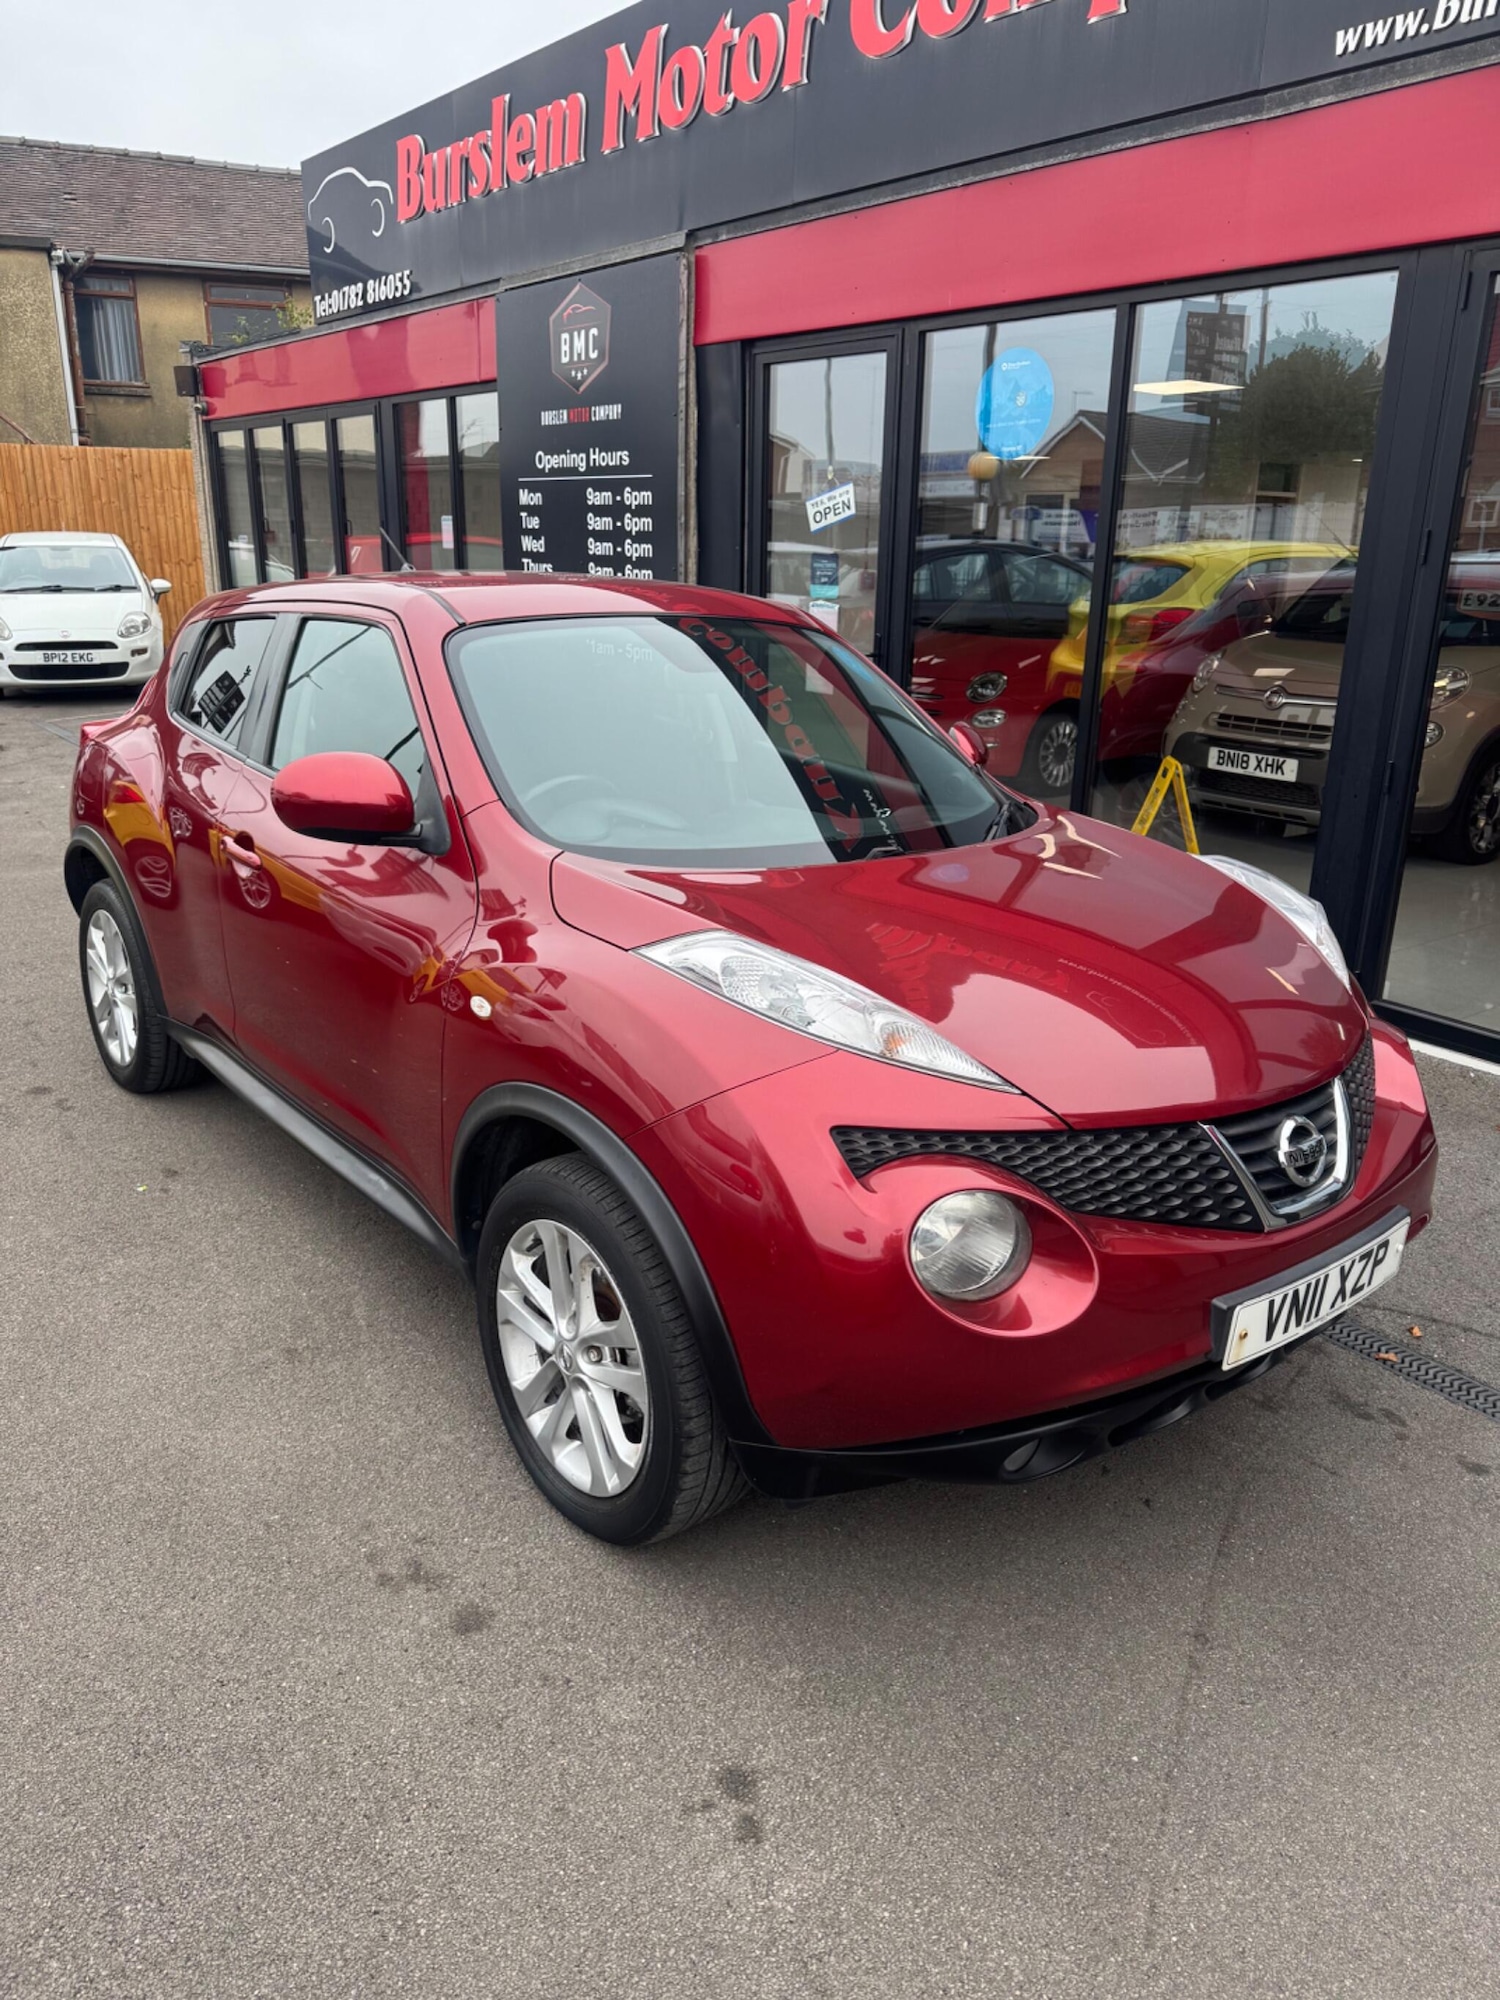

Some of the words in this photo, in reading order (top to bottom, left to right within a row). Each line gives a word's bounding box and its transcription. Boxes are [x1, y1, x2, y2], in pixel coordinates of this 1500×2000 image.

[396, 92, 587, 224] Burslem
[600, 0, 829, 155] Motor
[314, 282, 364, 318] Tel:01782
[366, 269, 412, 304] 816055
[560, 327, 598, 364] BMC
[535, 449, 587, 473] Opening
[589, 447, 630, 467] Hours
[518, 488, 543, 506] Mon
[586, 487, 613, 506] 9am
[623, 486, 653, 509] 6pm
[519, 512, 540, 529] Tue
[586, 512, 613, 531] 9am
[623, 512, 653, 536] 6pm
[813, 498, 851, 524] OPEN
[521, 535, 545, 553] Wed
[587, 537, 614, 556] 9am
[623, 538, 653, 561] 6pm
[521, 558, 553, 573] Thurs
[43, 652, 68, 663] BP12
[71, 652, 94, 663] EKG
[1216, 750, 1250, 770] BN18
[1253, 756, 1287, 776] XHK
[1265, 1274, 1330, 1342] VN11
[1330, 1239, 1390, 1310] XZP
